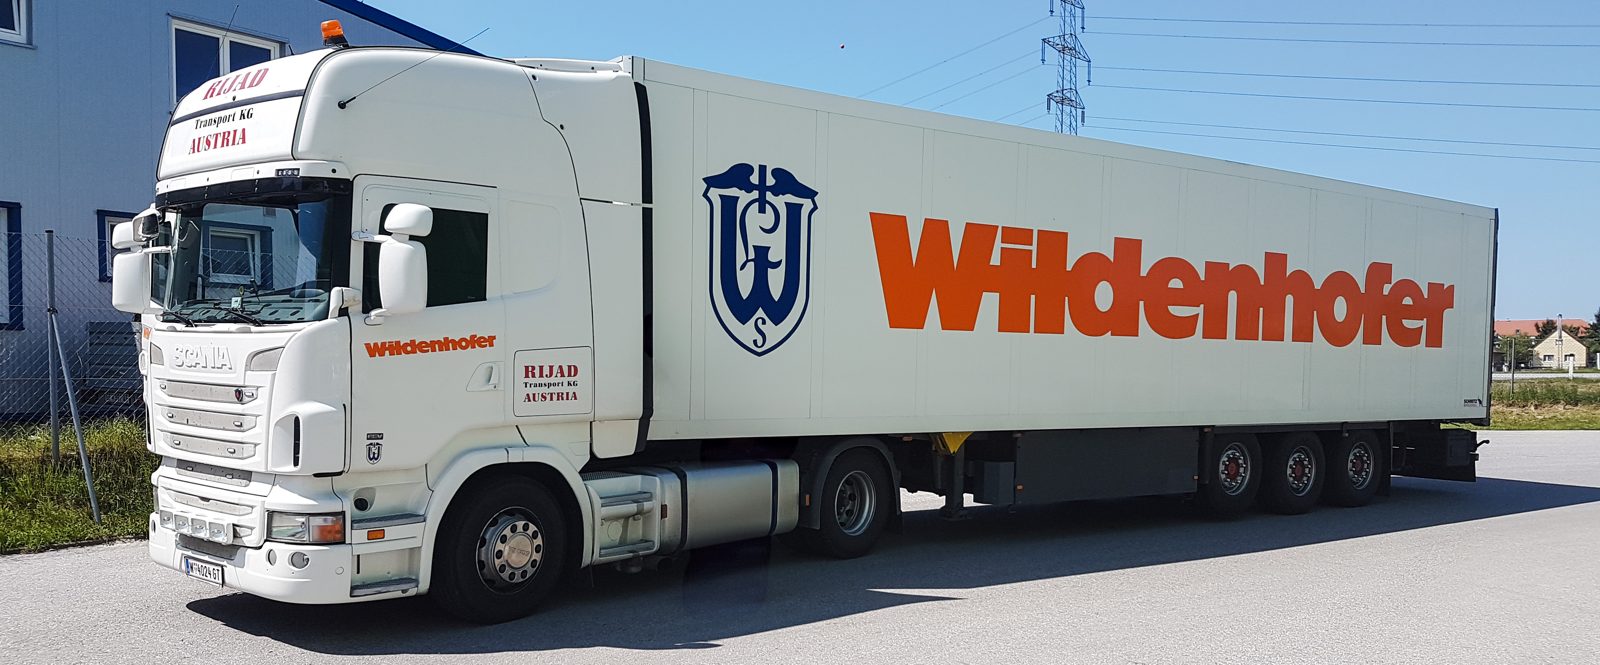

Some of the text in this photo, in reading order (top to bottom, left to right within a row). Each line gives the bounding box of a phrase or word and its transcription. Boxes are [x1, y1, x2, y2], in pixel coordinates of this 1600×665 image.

[203, 68, 269, 100] RIJAD
[195, 107, 254, 130] Transport KG
[188, 127, 247, 155] AUSTRIA
[869, 211, 1455, 349] Wildenhofer
[173, 344, 233, 370] SCANIA
[364, 334, 497, 358] Wildenhofer
[523, 364, 579, 379] RIJAD
[523, 380, 579, 389] Transport KG
[523, 391, 578, 403] AUSTRIA
